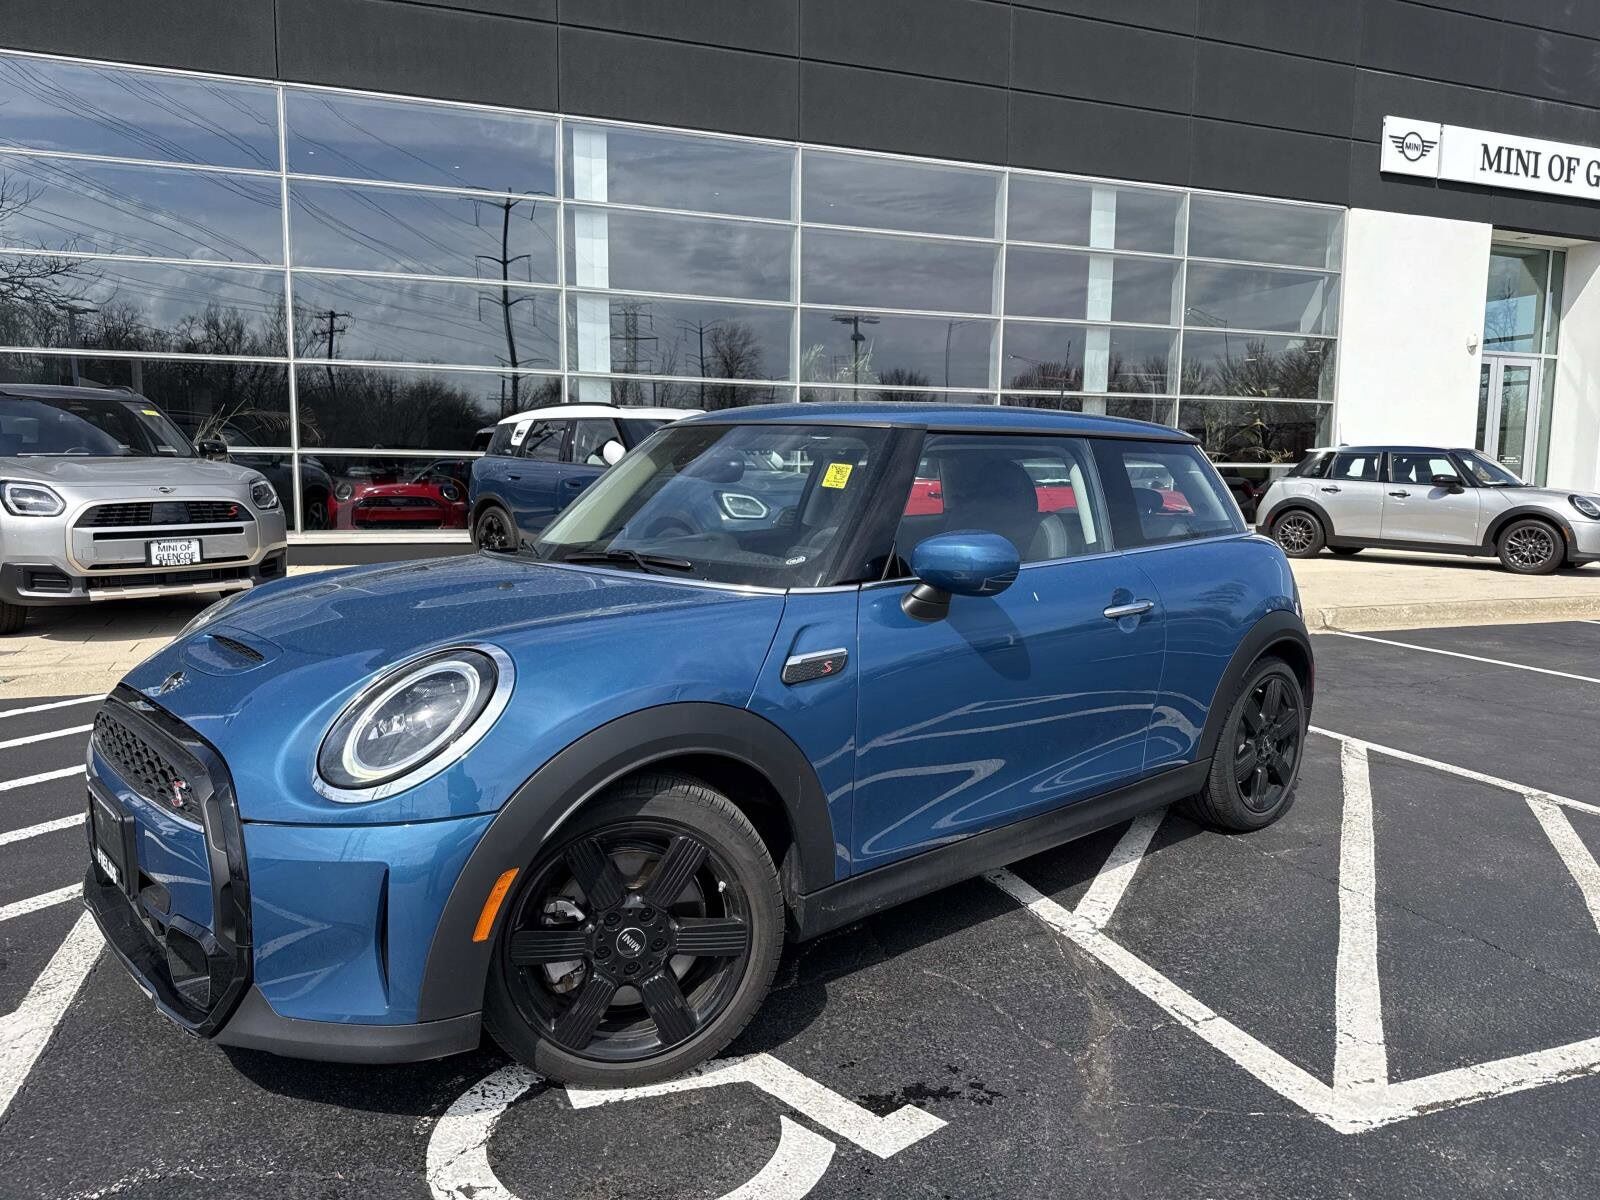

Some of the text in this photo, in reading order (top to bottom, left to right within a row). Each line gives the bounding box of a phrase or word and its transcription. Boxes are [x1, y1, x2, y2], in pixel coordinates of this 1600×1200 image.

[1405, 142, 1421, 151] MINI
[1480, 143, 1600, 187] MINI OF G
[157, 544, 178, 552] MINI
[156, 552, 195, 561] GLENCOE
[823, 660, 833, 673] S
[621, 933, 641, 951] MINI
